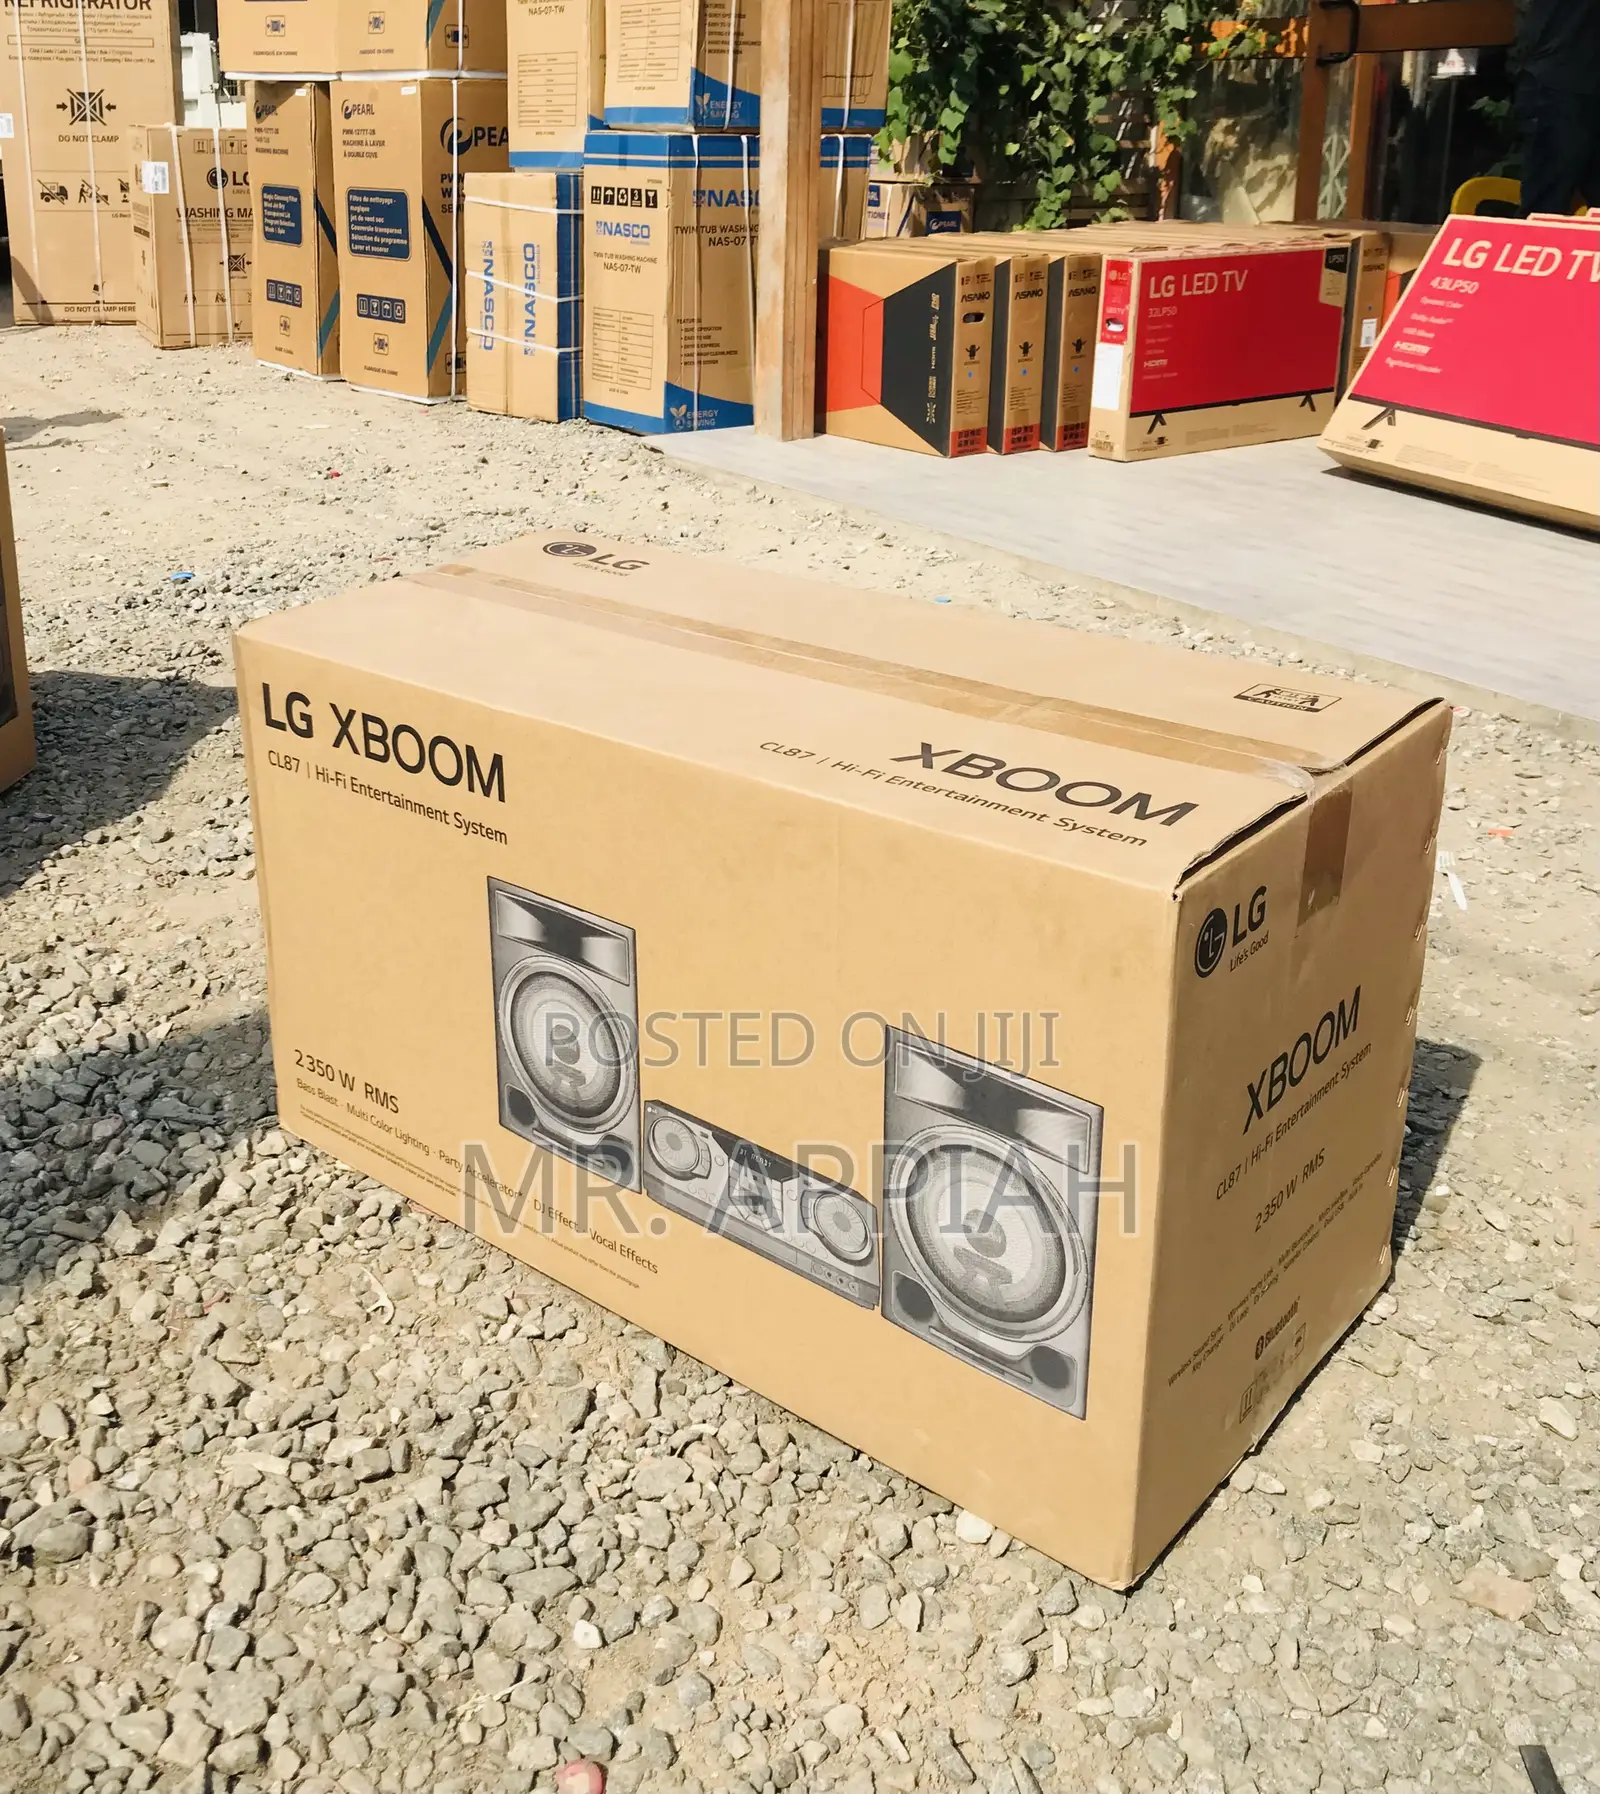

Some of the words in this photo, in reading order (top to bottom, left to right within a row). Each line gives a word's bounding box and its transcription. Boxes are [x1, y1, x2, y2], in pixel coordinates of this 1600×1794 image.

[352, 103, 375, 116] PEARL
[91, 135, 119, 143] CLAMP
[603, 220, 650, 239] NASCO
[674, 226, 698, 235] TWIN
[700, 226, 717, 234] TUB
[604, 262, 642, 274] NAS-07-TW
[1328, 255, 1345, 264] LP50
[1443, 238, 1492, 269] LG
[1494, 243, 1563, 277] LED
[483, 258, 495, 350] NASCO
[523, 243, 536, 338] NASCO
[961, 292, 990, 303] ASANO
[1015, 289, 1044, 300] ASANO
[1150, 276, 1175, 299] LG
[1181, 272, 1219, 298] LED
[1222, 269, 1249, 293] TV
[1430, 276, 1480, 294] 43LP50
[588, 554, 650, 571] LG
[1248, 697, 1308, 711] CAUTION
[262, 682, 314, 739] LG
[329, 702, 506, 803] XBOOM
[268, 750, 301, 775] CL87
[316, 764, 347, 790] Hi-Fi
[351, 776, 450, 825] Entertainment
[453, 812, 508, 846] System
[760, 742, 817, 760] CL87
[831, 760, 887, 780] Hi-Fi
[884, 774, 1050, 823] Entertainment
[1055, 816, 1148, 847] System
[889, 741, 1200, 828] XBOOM
[1232, 884, 1268, 948] LG
[1230, 946, 1249, 973] Life's
[1250, 930, 1270, 957] Good
[1243, 984, 1362, 1137] XBOOM
[294, 1049, 335, 1082] 2350
[339, 1070, 355, 1092] W
[364, 1082, 400, 1114] RMS
[1216, 1163, 1242, 1201] CL87
[1251, 1132, 1274, 1167] Hi-Fi
[1275, 1071, 1339, 1144] Entertainment
[1341, 1042, 1372, 1081] System
[296, 1078, 316, 1096] Bass
[318, 1088, 339, 1108] Blast
[347, 1102, 369, 1122] Multi
[370, 1114, 394, 1136] Color
[394, 1127, 430, 1157] Lighting
[439, 1150, 463, 1173] Party
[534, 1198, 546, 1214] DJ
[590, 1228, 618, 1253] Vocal
[620, 1244, 658, 1274] Effects
[1255, 1191, 1284, 1232] 2350
[1286, 1174, 1298, 1200] W
[1301, 1148, 1326, 1185] RMS
